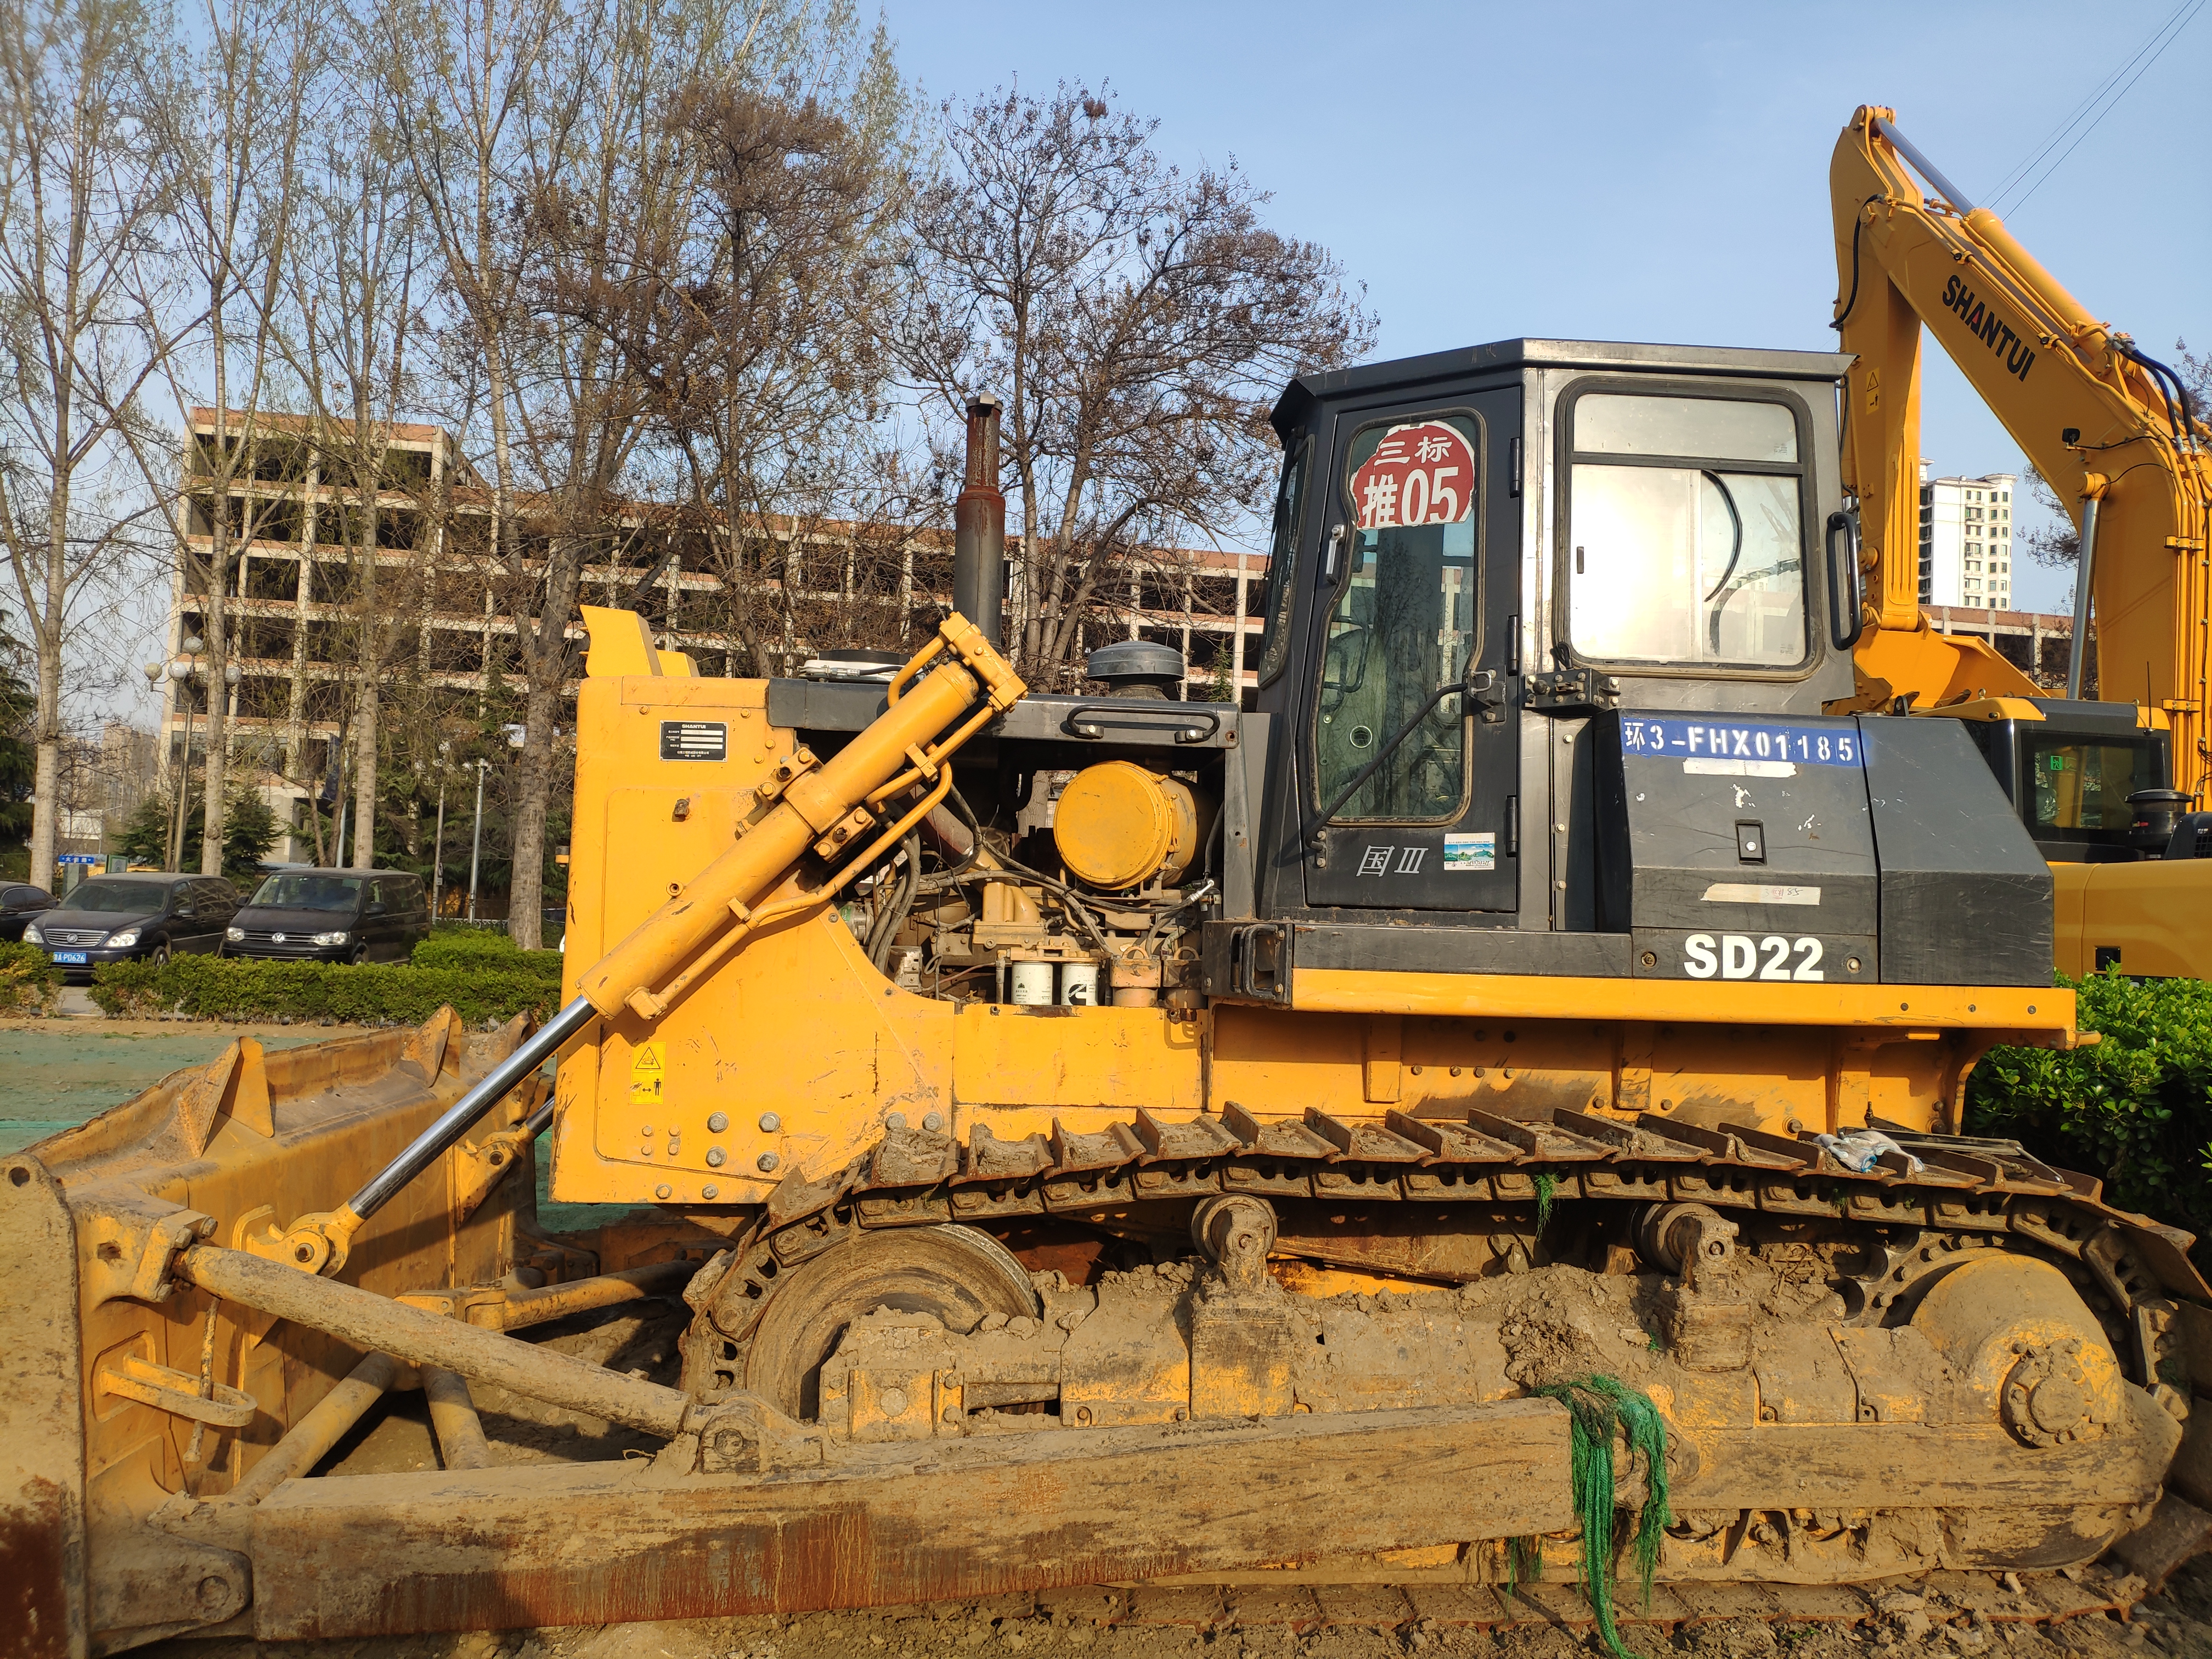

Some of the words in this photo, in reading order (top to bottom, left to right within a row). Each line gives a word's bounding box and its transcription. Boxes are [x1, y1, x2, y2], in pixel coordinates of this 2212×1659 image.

[1943, 275, 2036, 382] SHANTUI
[1374, 436, 1453, 466] 三标
[1684, 934, 1824, 981] SD22
